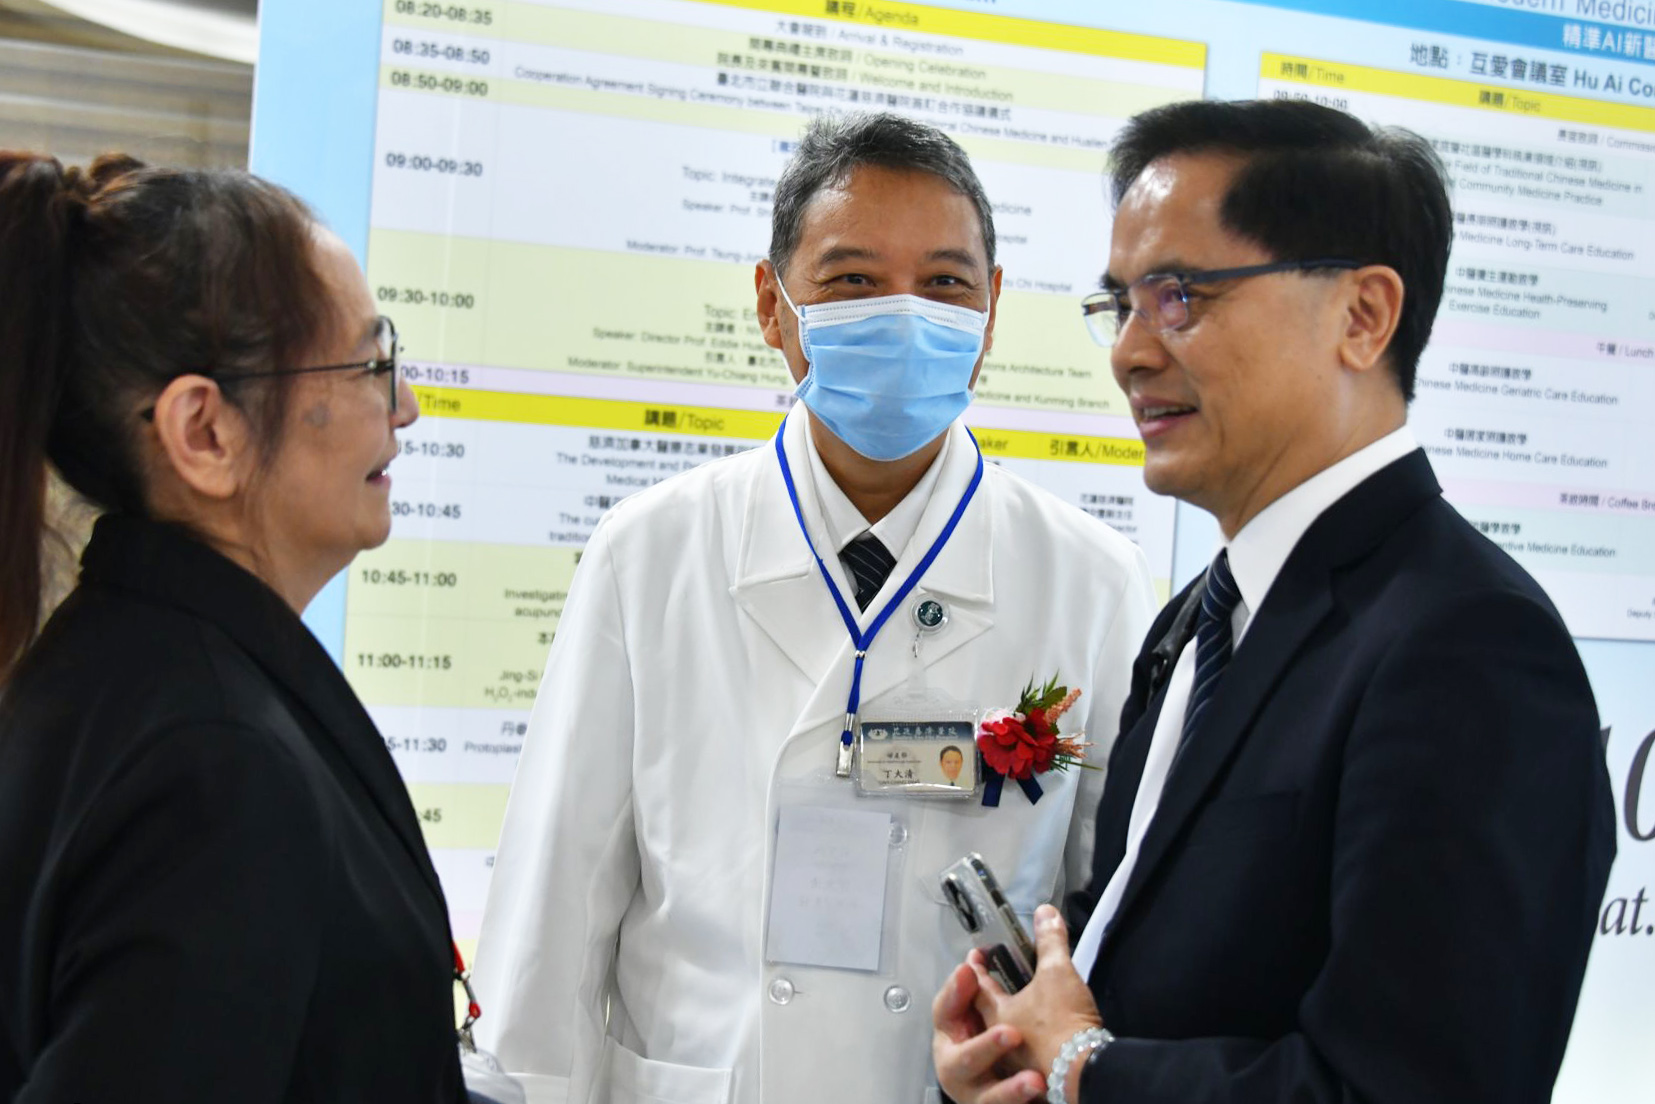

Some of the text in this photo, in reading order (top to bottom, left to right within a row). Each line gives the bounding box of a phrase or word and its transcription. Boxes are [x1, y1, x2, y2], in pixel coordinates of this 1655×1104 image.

[395, 0, 493, 26] 08:20-08:35
[392, 38, 491, 65] 08:35-08:50
[892, 36, 964, 56] Registration
[390, 71, 489, 97] 08:50-09:00
[1573, 69, 1599, 91] Hu
[1603, 73, 1623, 94] Ai
[514, 66, 583, 85] Cooperation
[585, 75, 645, 93] Agreement
[647, 82, 687, 101] Signing
[690, 88, 744, 108] Ceremony
[1003, 127, 1048, 142] Medicine
[385, 152, 483, 178] 09:00-09:30
[1494, 165, 1543, 182] Traditional
[1546, 171, 1586, 187] Chinese
[1588, 177, 1631, 193] Medicine
[1459, 179, 1515, 197] Community
[1518, 184, 1561, 200] Medicine
[1458, 229, 1503, 246] Medicine
[1560, 242, 1584, 256] Care
[1586, 245, 1634, 261] Education
[377, 287, 475, 309] 09:30-10:00
[1477, 286, 1520, 301] Medicine
[1449, 301, 1541, 319] Exercise Education
[400, 366, 470, 384] 00-10:15
[626, 361, 703, 377] Superintendent
[1454, 380, 1498, 395] Medicine
[1501, 384, 1542, 398] Geriatric
[1544, 387, 1568, 401] Care
[1571, 390, 1619, 406] Education
[556, 452, 578, 465] The
[581, 453, 656, 469] Development
[658, 460, 680, 471] and
[1456, 445, 1500, 460] Medicine
[1502, 448, 1531, 463] Home
[1534, 452, 1558, 466] Care
[1560, 454, 1608, 469] Education
[606, 474, 649, 487] Medical
[391, 501, 462, 519] 30-10:45
[1607, 496, 1639, 510] Coffee
[559, 511, 581, 525] The
[1527, 542, 1569, 556] Medicine
[1571, 544, 1616, 559] Education
[361, 569, 457, 588] 10:45-11:00
[358, 652, 452, 670] 11:00-11:15
[386, 737, 447, 752] 5-11:30
